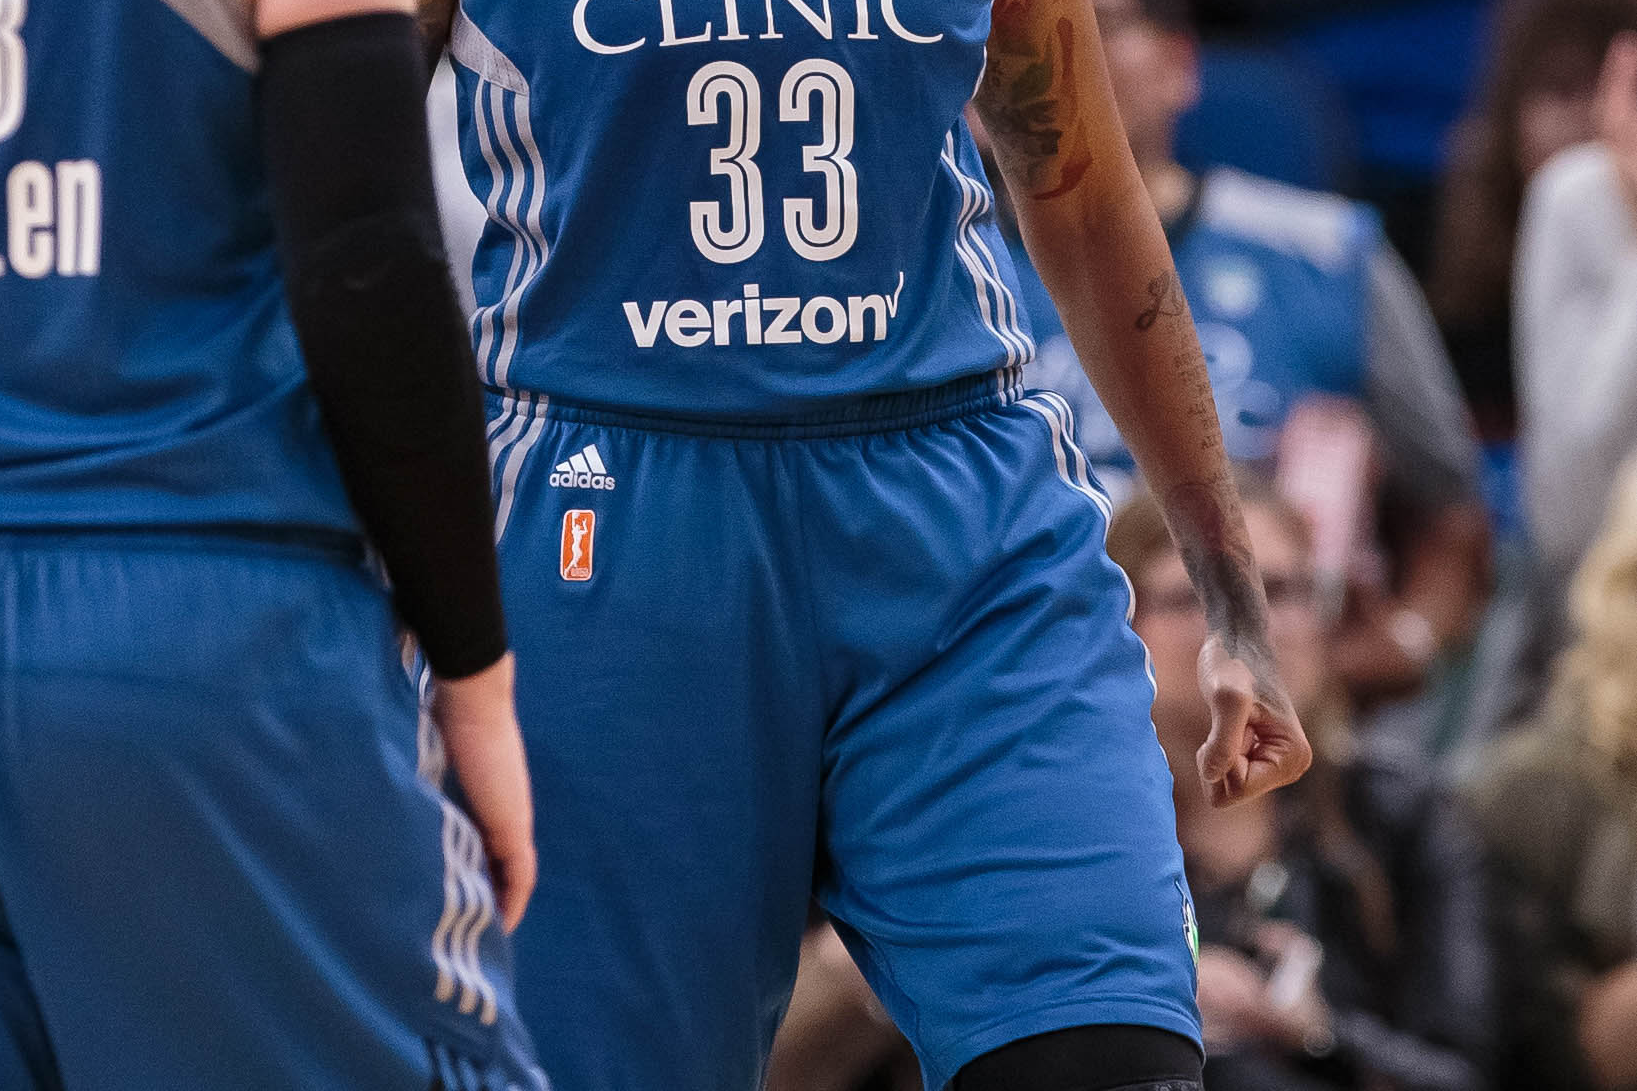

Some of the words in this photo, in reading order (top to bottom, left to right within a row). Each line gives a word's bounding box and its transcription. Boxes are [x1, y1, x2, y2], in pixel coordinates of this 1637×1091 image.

[686, 58, 859, 264] 33
[622, 283, 887, 348] verizon
[549, 470, 616, 491] adidas
